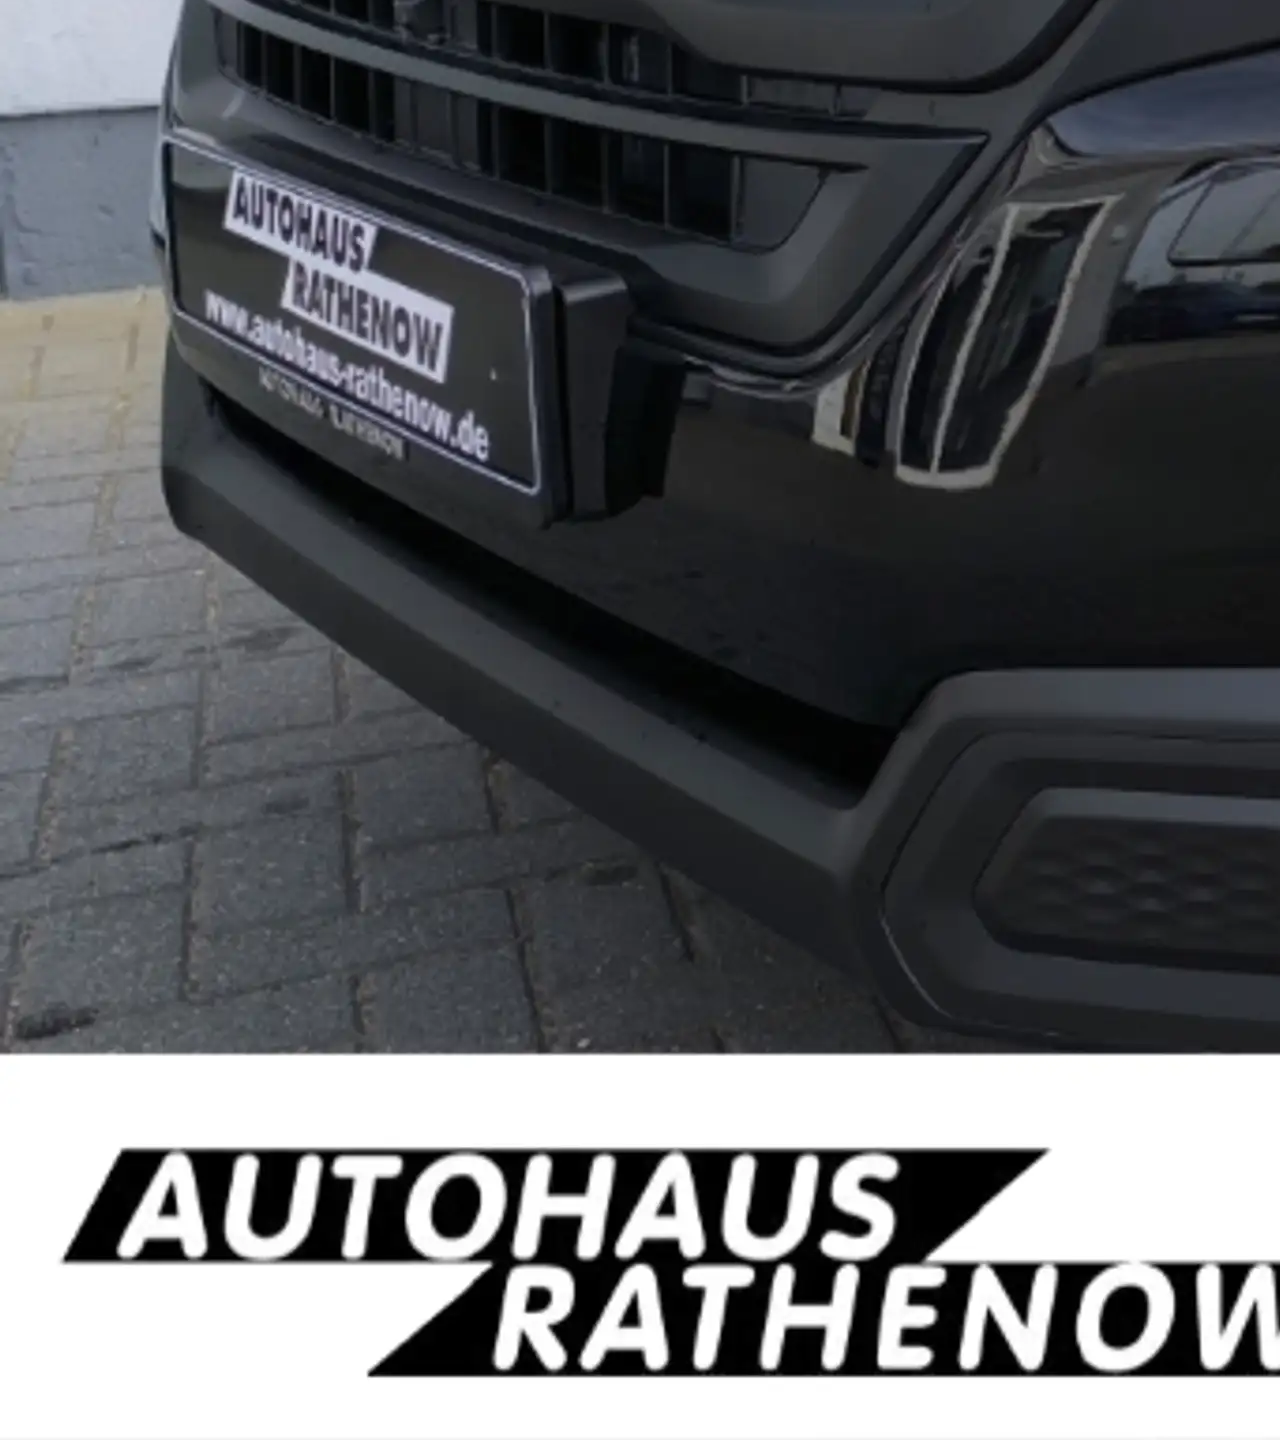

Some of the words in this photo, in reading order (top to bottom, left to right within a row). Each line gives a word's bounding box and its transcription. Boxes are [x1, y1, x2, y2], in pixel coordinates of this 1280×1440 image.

[231, 177, 367, 271] AUTOHAUS
[292, 262, 443, 373] RATHENOW
[205, 290, 489, 461] www.autohaus-rathenow.de
